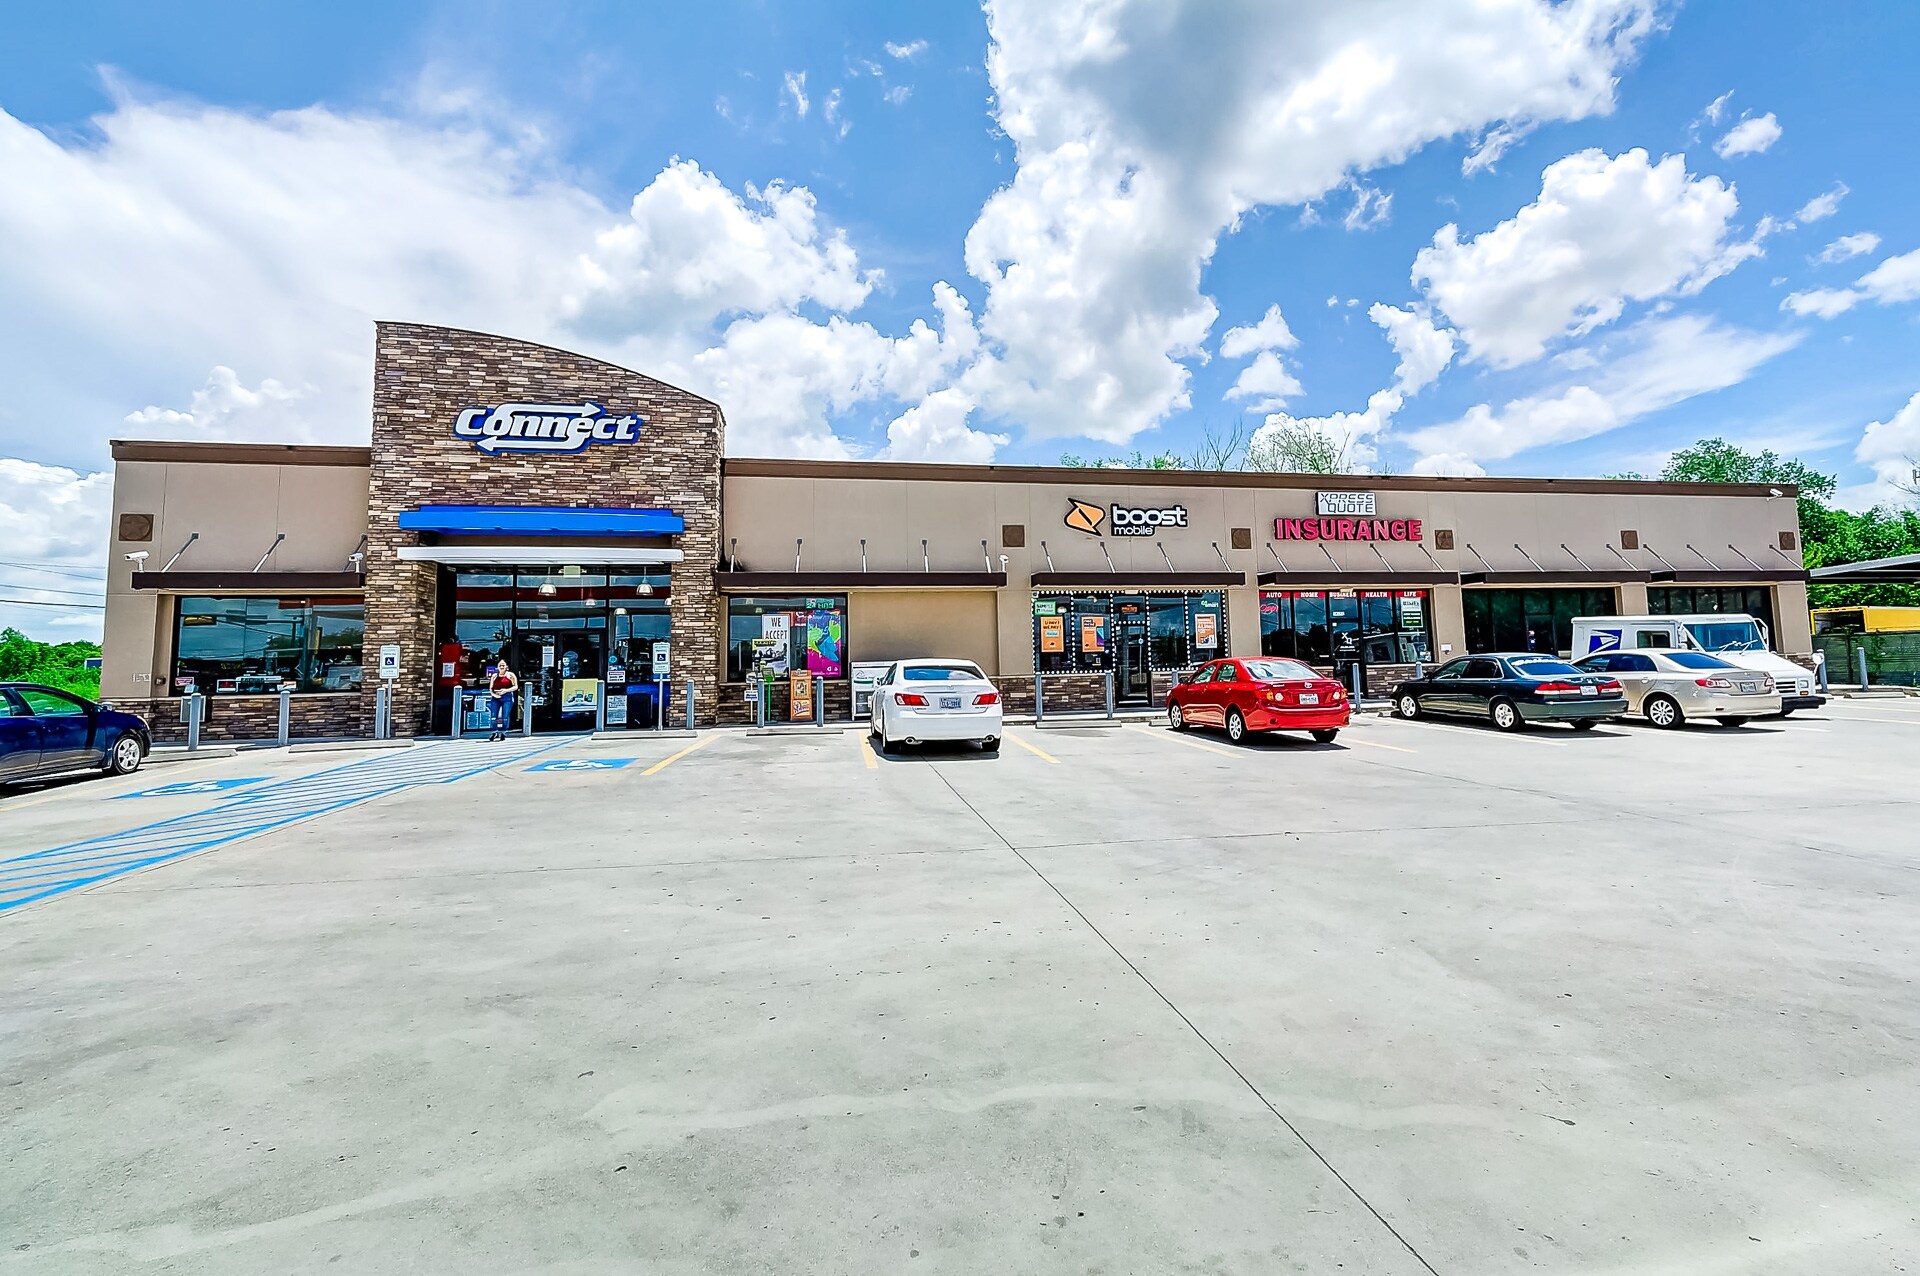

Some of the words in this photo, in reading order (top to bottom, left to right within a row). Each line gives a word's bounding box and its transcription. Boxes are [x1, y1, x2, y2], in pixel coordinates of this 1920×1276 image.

[1319, 493, 1374, 503] XPRESS
[1327, 503, 1374, 513] QUOTE
[1112, 506, 1187, 526] boost
[1114, 525, 1153, 535] mobile
[1274, 518, 1423, 541] INSURANCE
[771, 617, 782, 628] WE
[765, 630, 788, 640] ACCEPT
